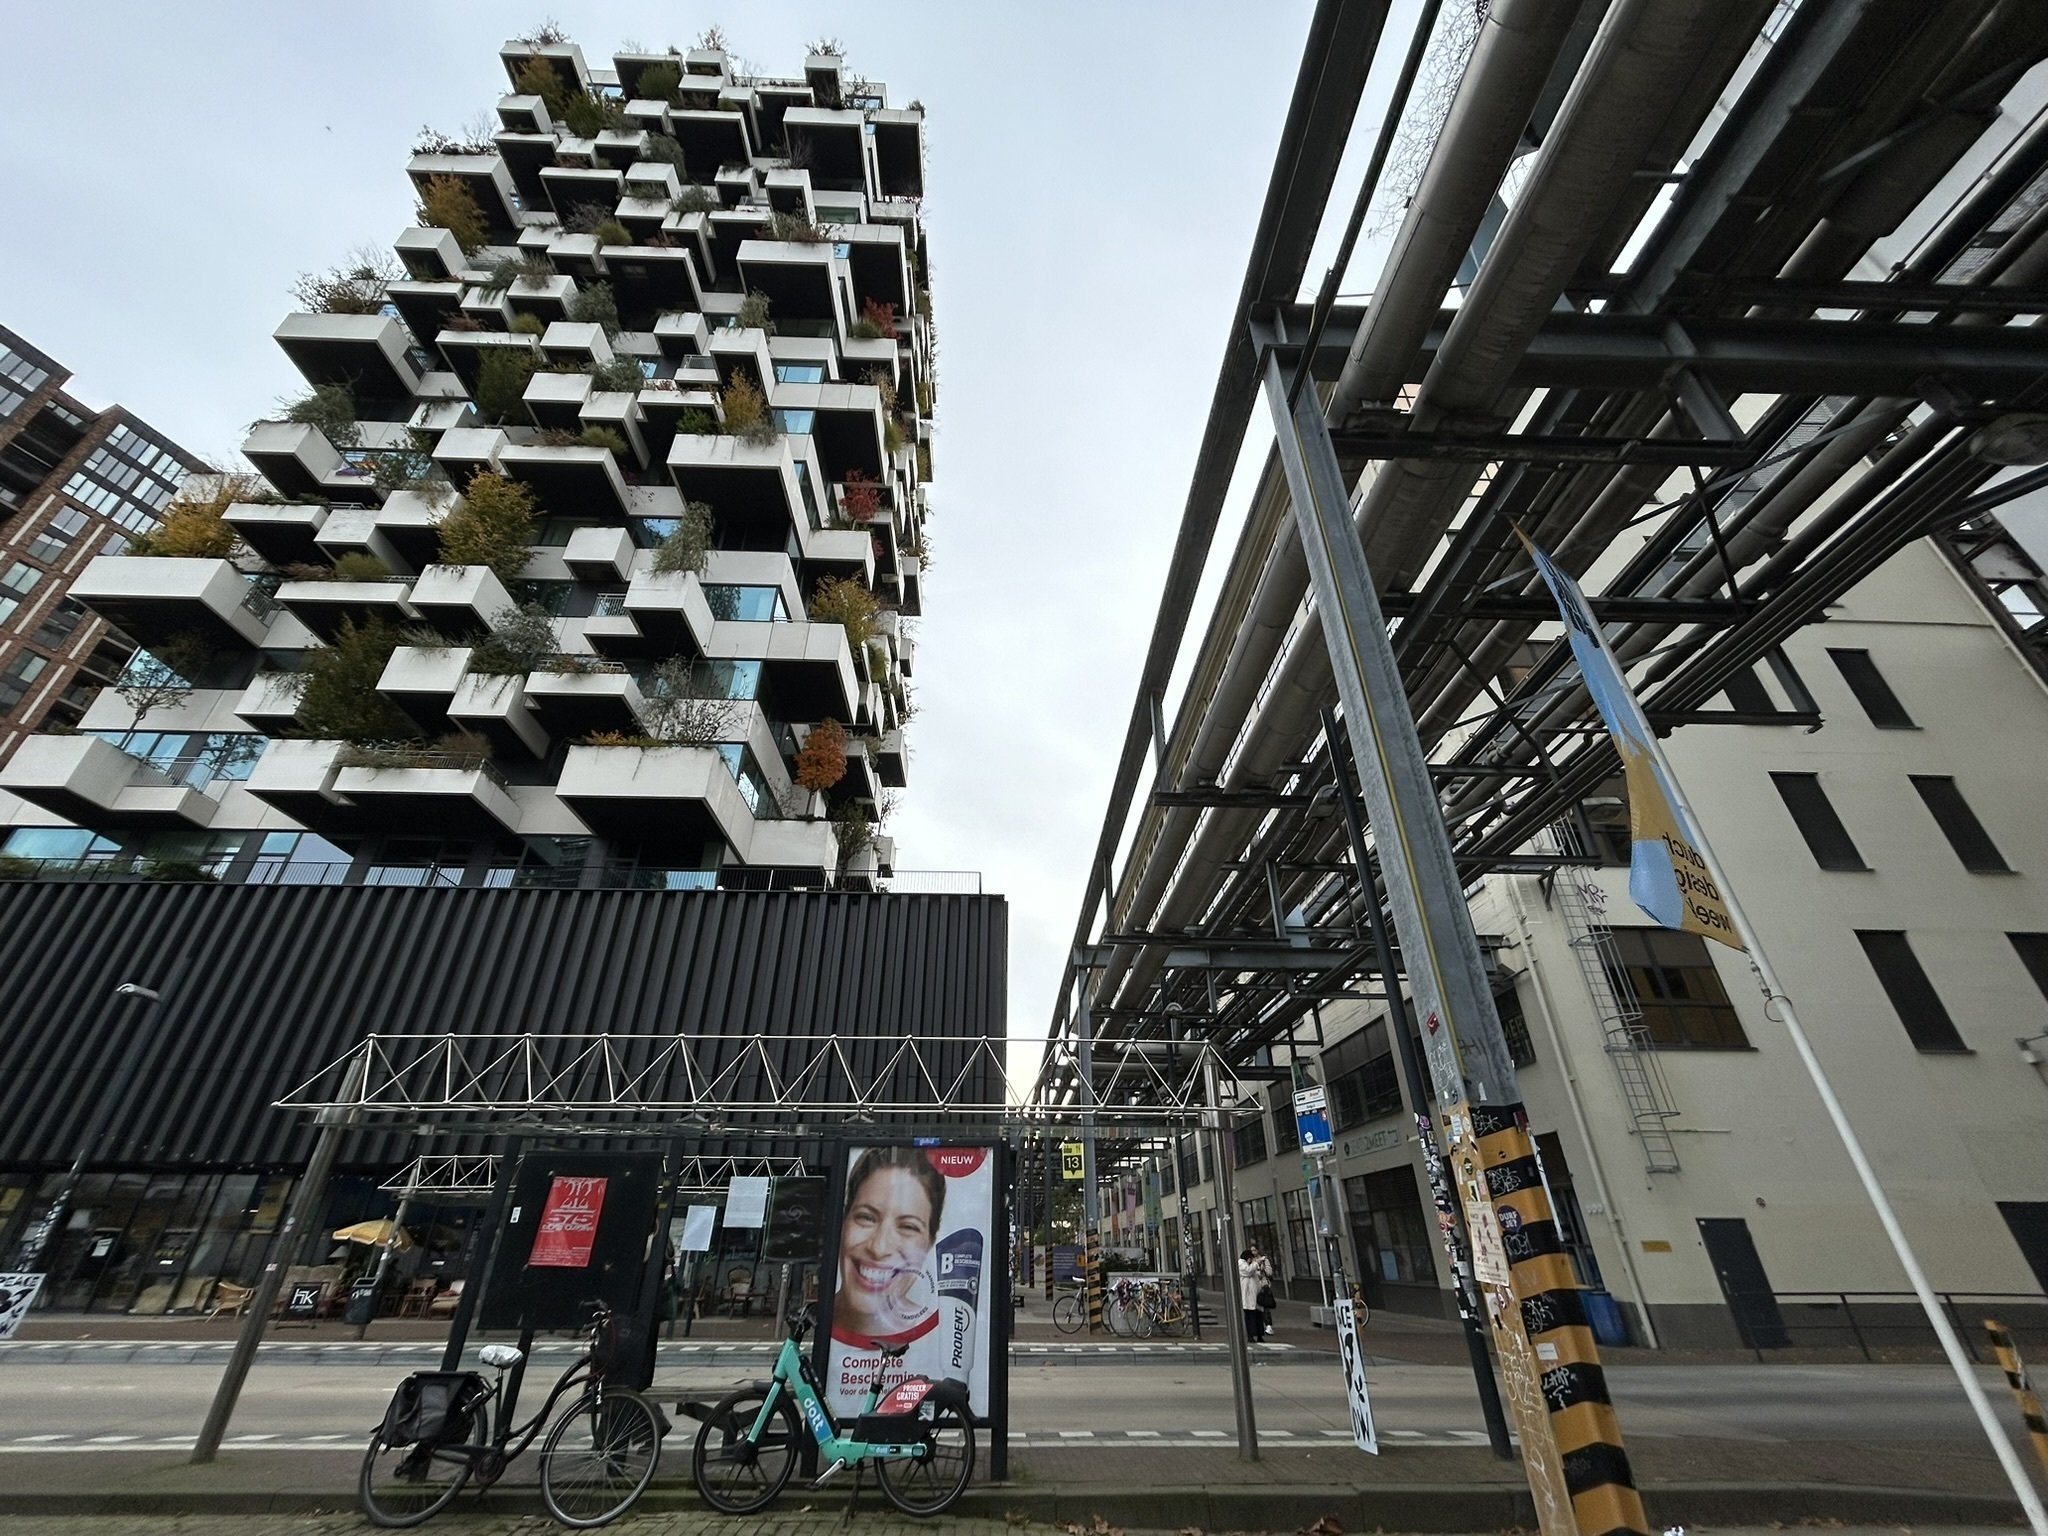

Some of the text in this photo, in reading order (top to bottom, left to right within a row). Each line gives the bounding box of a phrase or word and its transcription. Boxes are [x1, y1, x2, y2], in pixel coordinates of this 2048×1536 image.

[940, 1155, 974, 1165] NIEUW
[1066, 1156, 1080, 1169] 13
[1498, 1210, 1518, 1222] DURF
[941, 1253, 954, 1275] B
[951, 1306, 964, 1368] PRODENT
[842, 1356, 903, 1370] Compete
[841, 1371, 918, 1385] Beschermin
[840, 1387, 857, 1395] Voor
[896, 1391, 920, 1401] GRATIS!
[803, 1397, 825, 1432] dott
